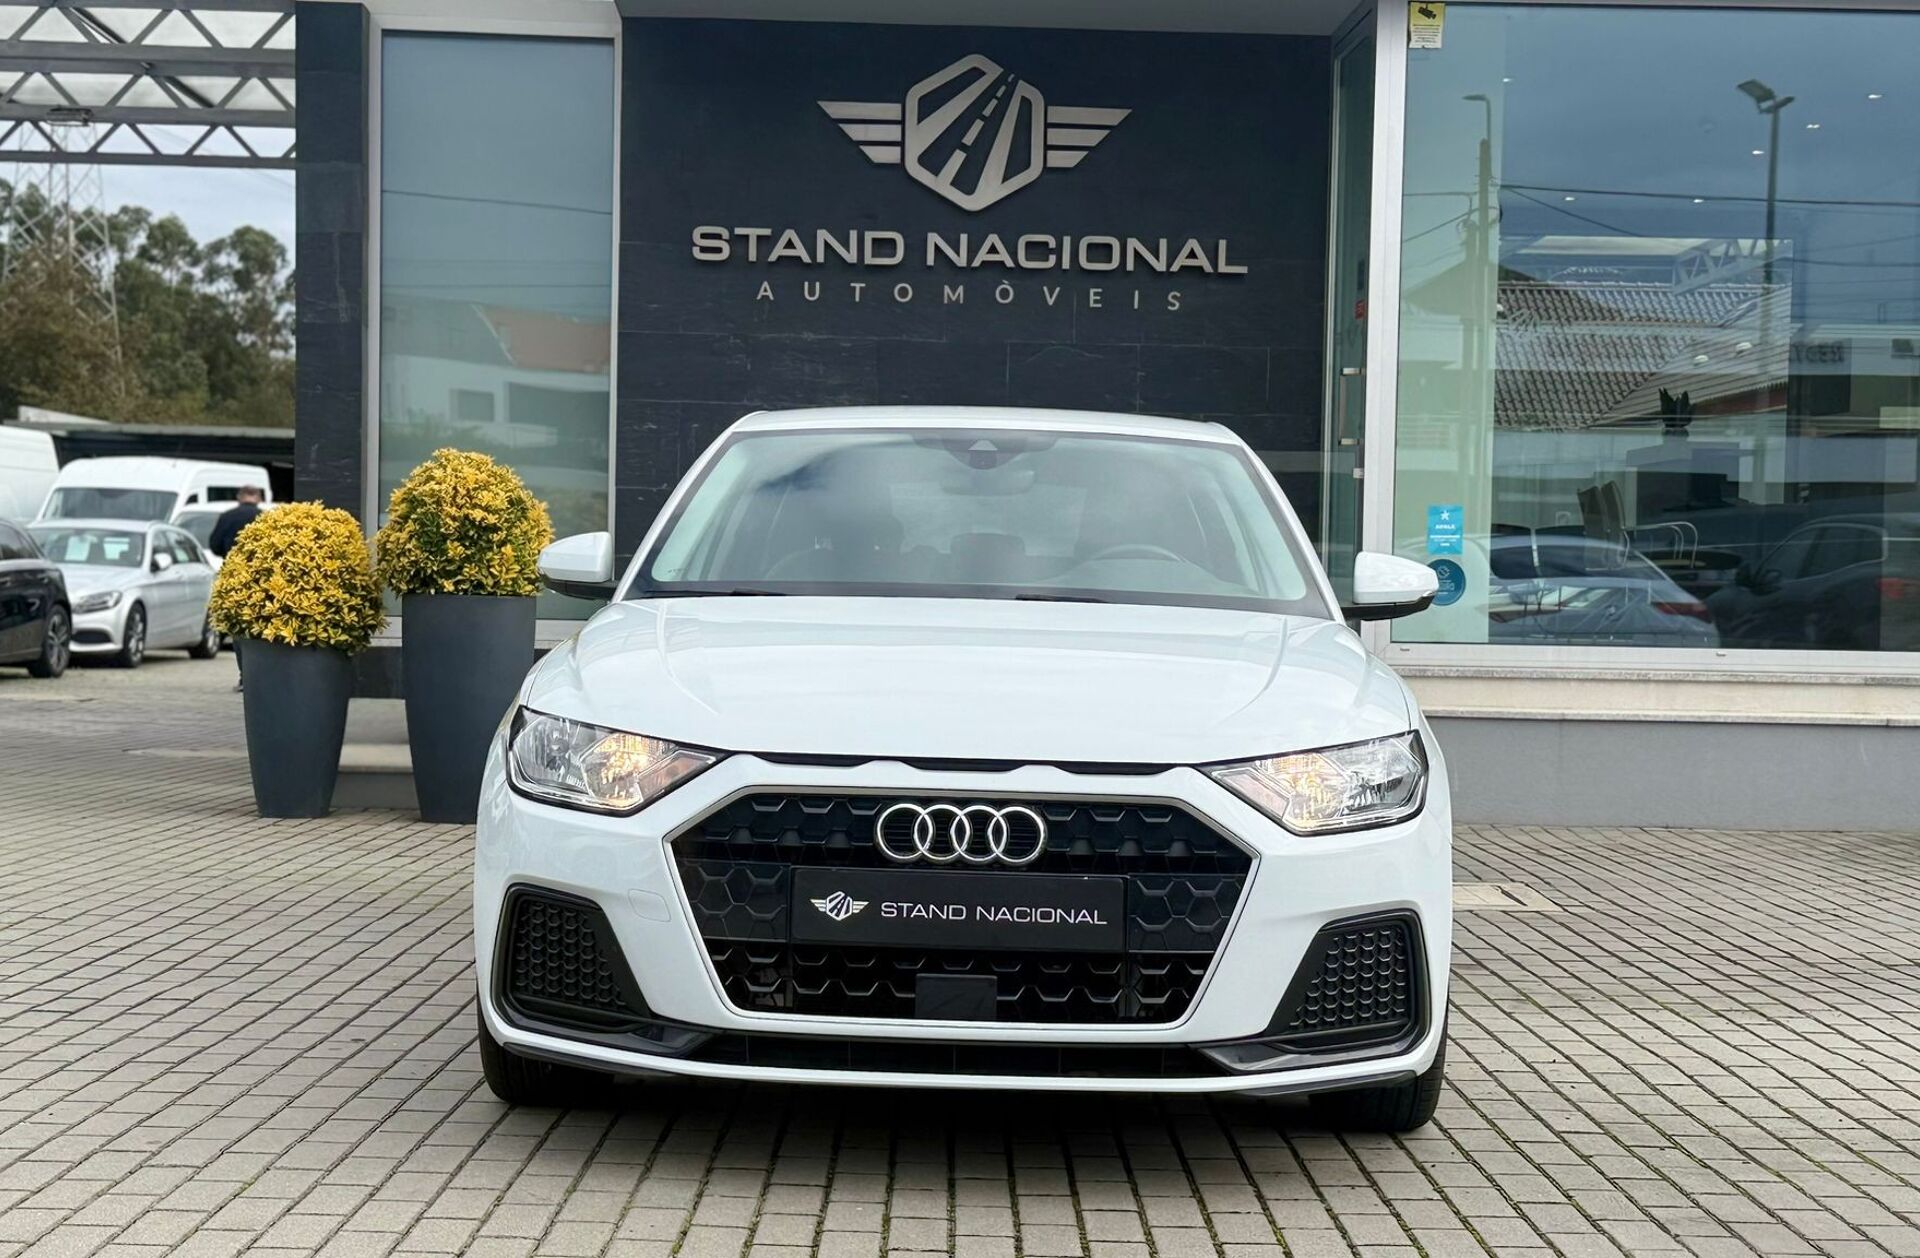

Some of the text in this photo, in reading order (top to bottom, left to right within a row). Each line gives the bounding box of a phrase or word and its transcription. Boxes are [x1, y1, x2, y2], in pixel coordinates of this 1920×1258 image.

[692, 225, 1248, 274] STAND NACIONAL
[880, 901, 1108, 925] STAND NACIONAL
